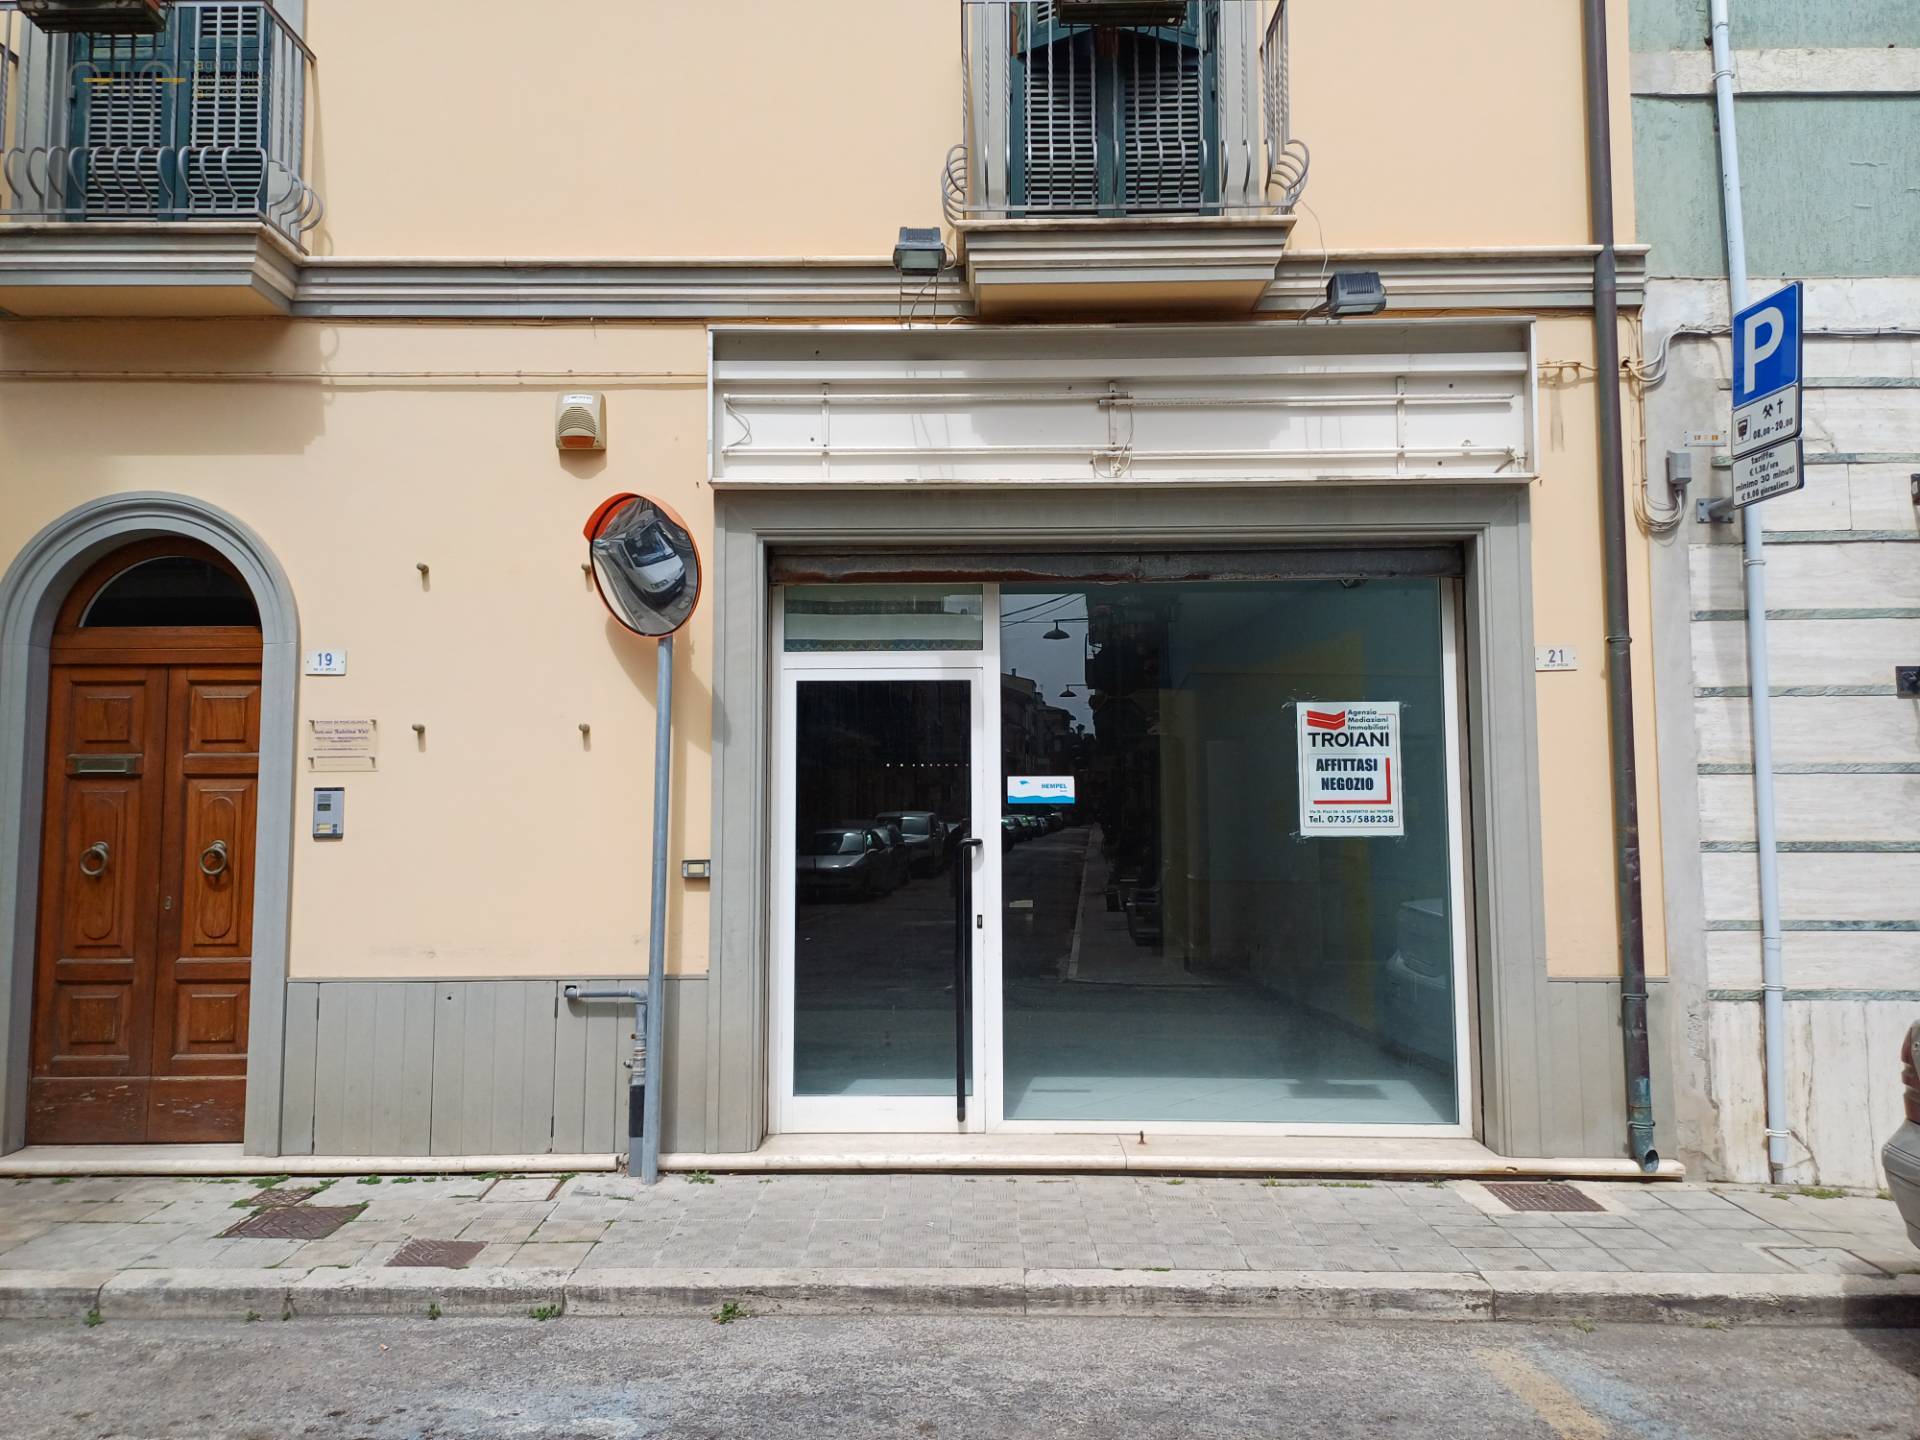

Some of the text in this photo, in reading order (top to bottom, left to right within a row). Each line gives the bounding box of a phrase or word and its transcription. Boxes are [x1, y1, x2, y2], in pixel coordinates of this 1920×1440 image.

[1743, 306, 1784, 395] P
[1735, 464, 1795, 492] minimo 30 minuti
[318, 652, 333, 667] 19
[1548, 649, 1563, 663] 21
[1347, 709, 1377, 717] Agenzia
[1307, 732, 1390, 748] TROIANI
[1315, 758, 1379, 772] AFFITTASI
[1320, 777, 1374, 791] NEGOZIO
[1308, 815, 1394, 825] Tel. 0735/588238
